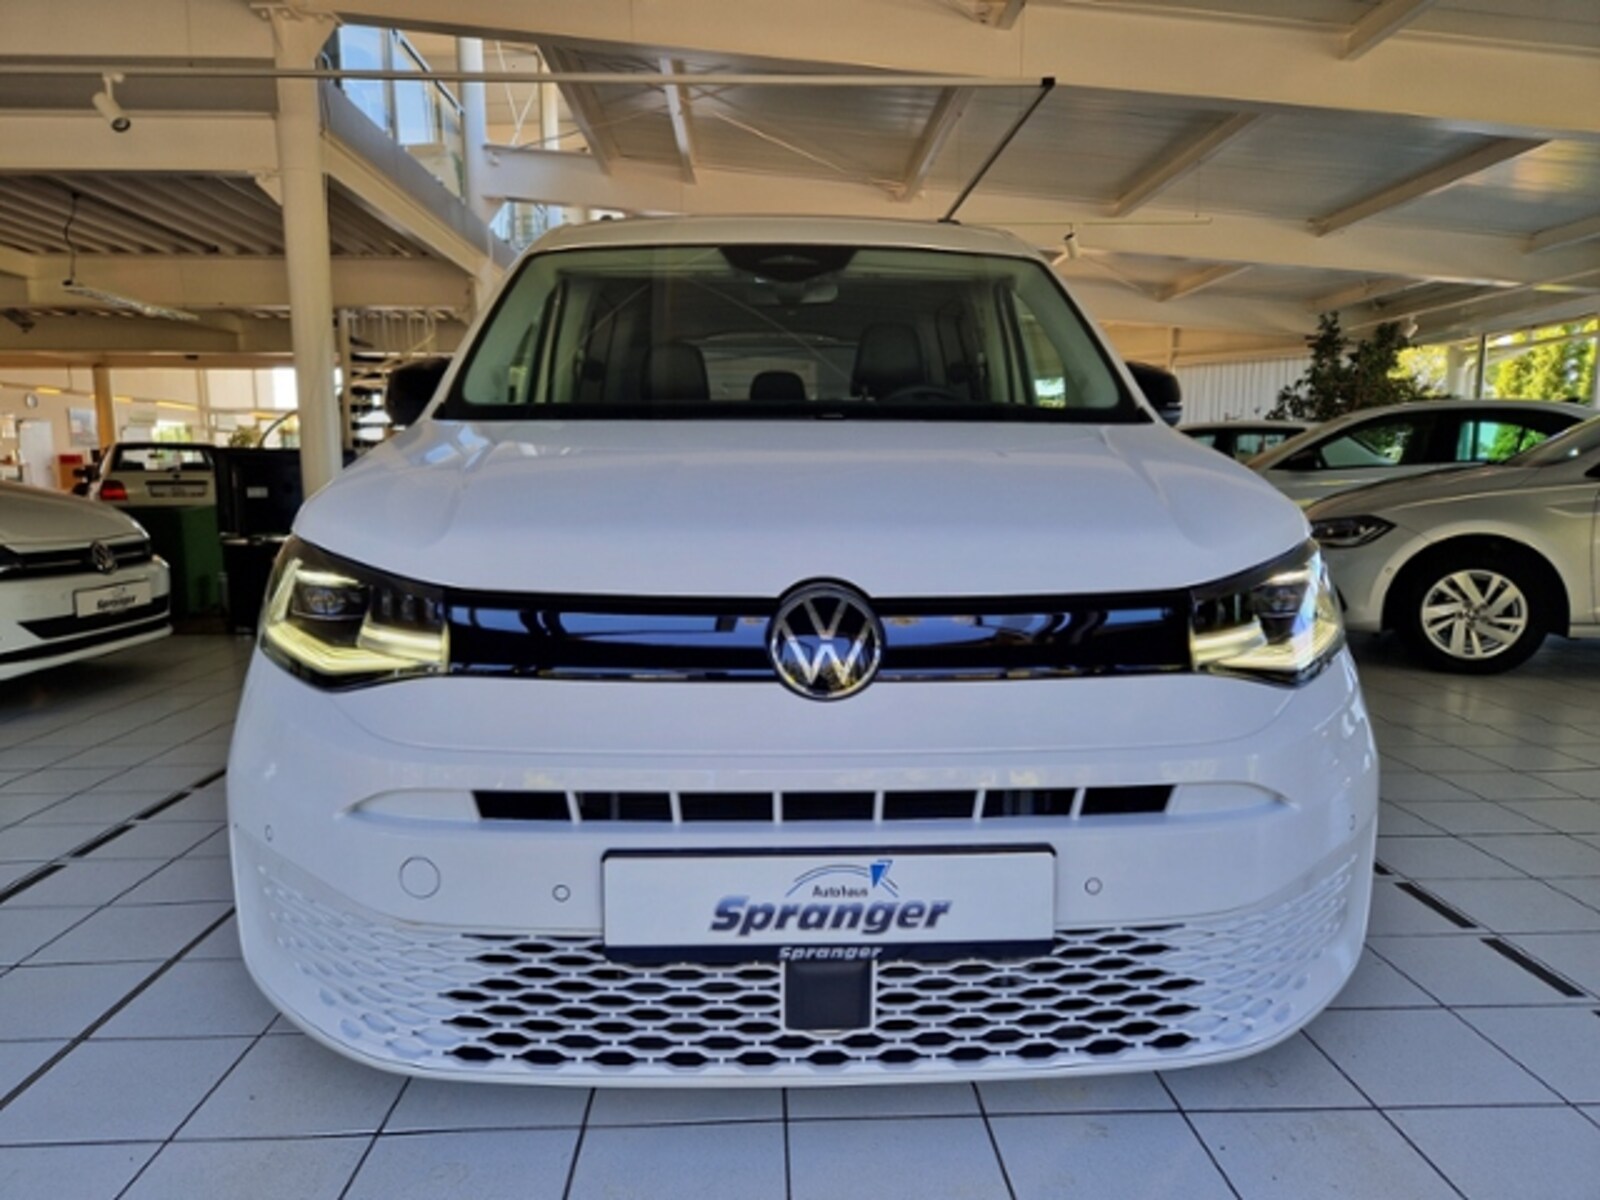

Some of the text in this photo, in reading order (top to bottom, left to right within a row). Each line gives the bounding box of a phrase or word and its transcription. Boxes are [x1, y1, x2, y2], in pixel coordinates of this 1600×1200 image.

[776, 593, 875, 690] VW
[812, 885, 868, 898] Autohaus
[709, 896, 952, 936] Spranger
[778, 946, 883, 960] Spranger
